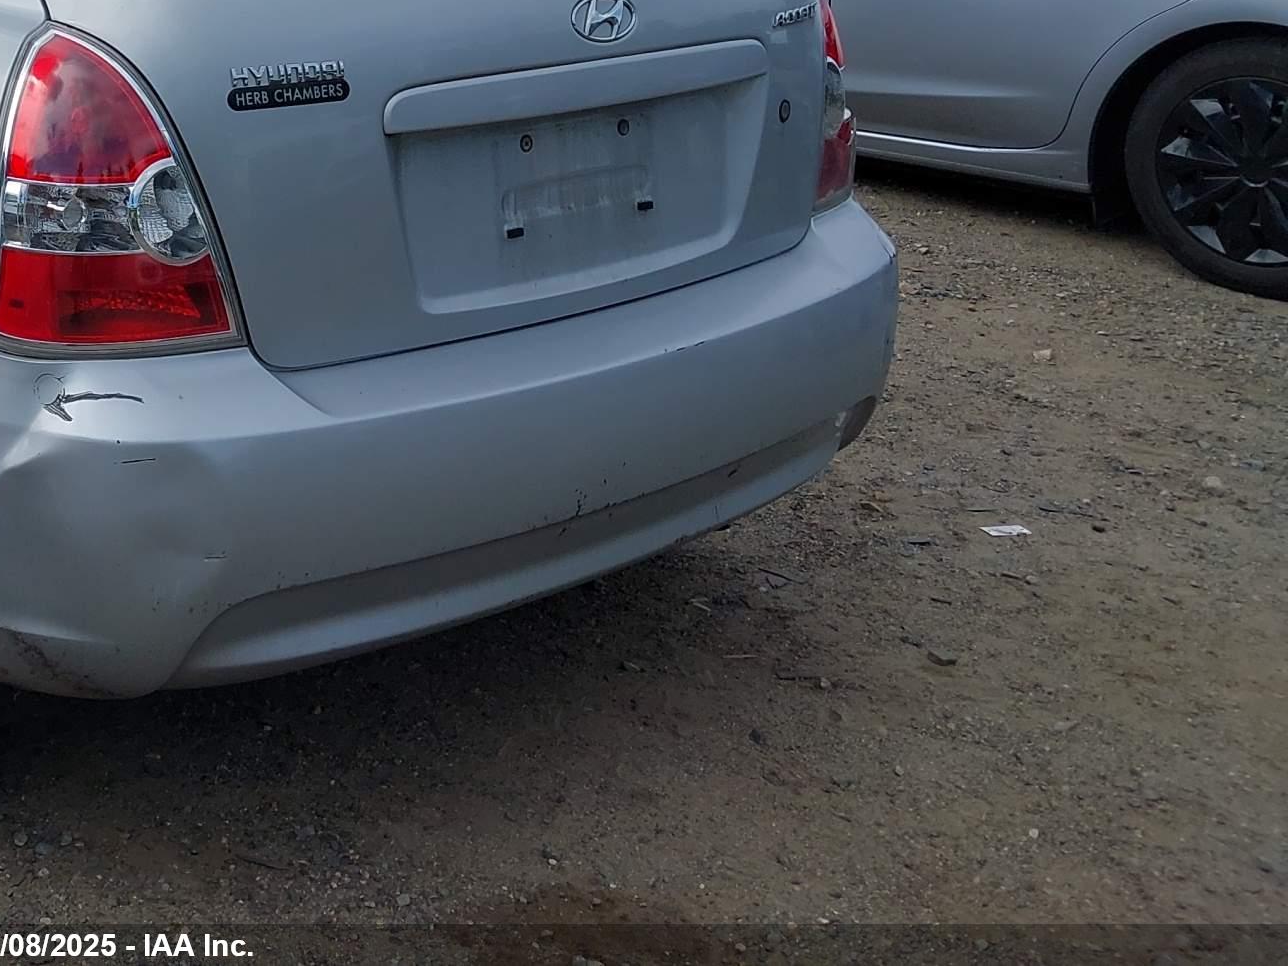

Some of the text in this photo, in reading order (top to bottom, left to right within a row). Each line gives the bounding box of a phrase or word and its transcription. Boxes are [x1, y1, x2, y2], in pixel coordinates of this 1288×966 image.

[230, 60, 345, 88] HYUNDAI
[235, 83, 344, 107] HERB CHAMBERS
